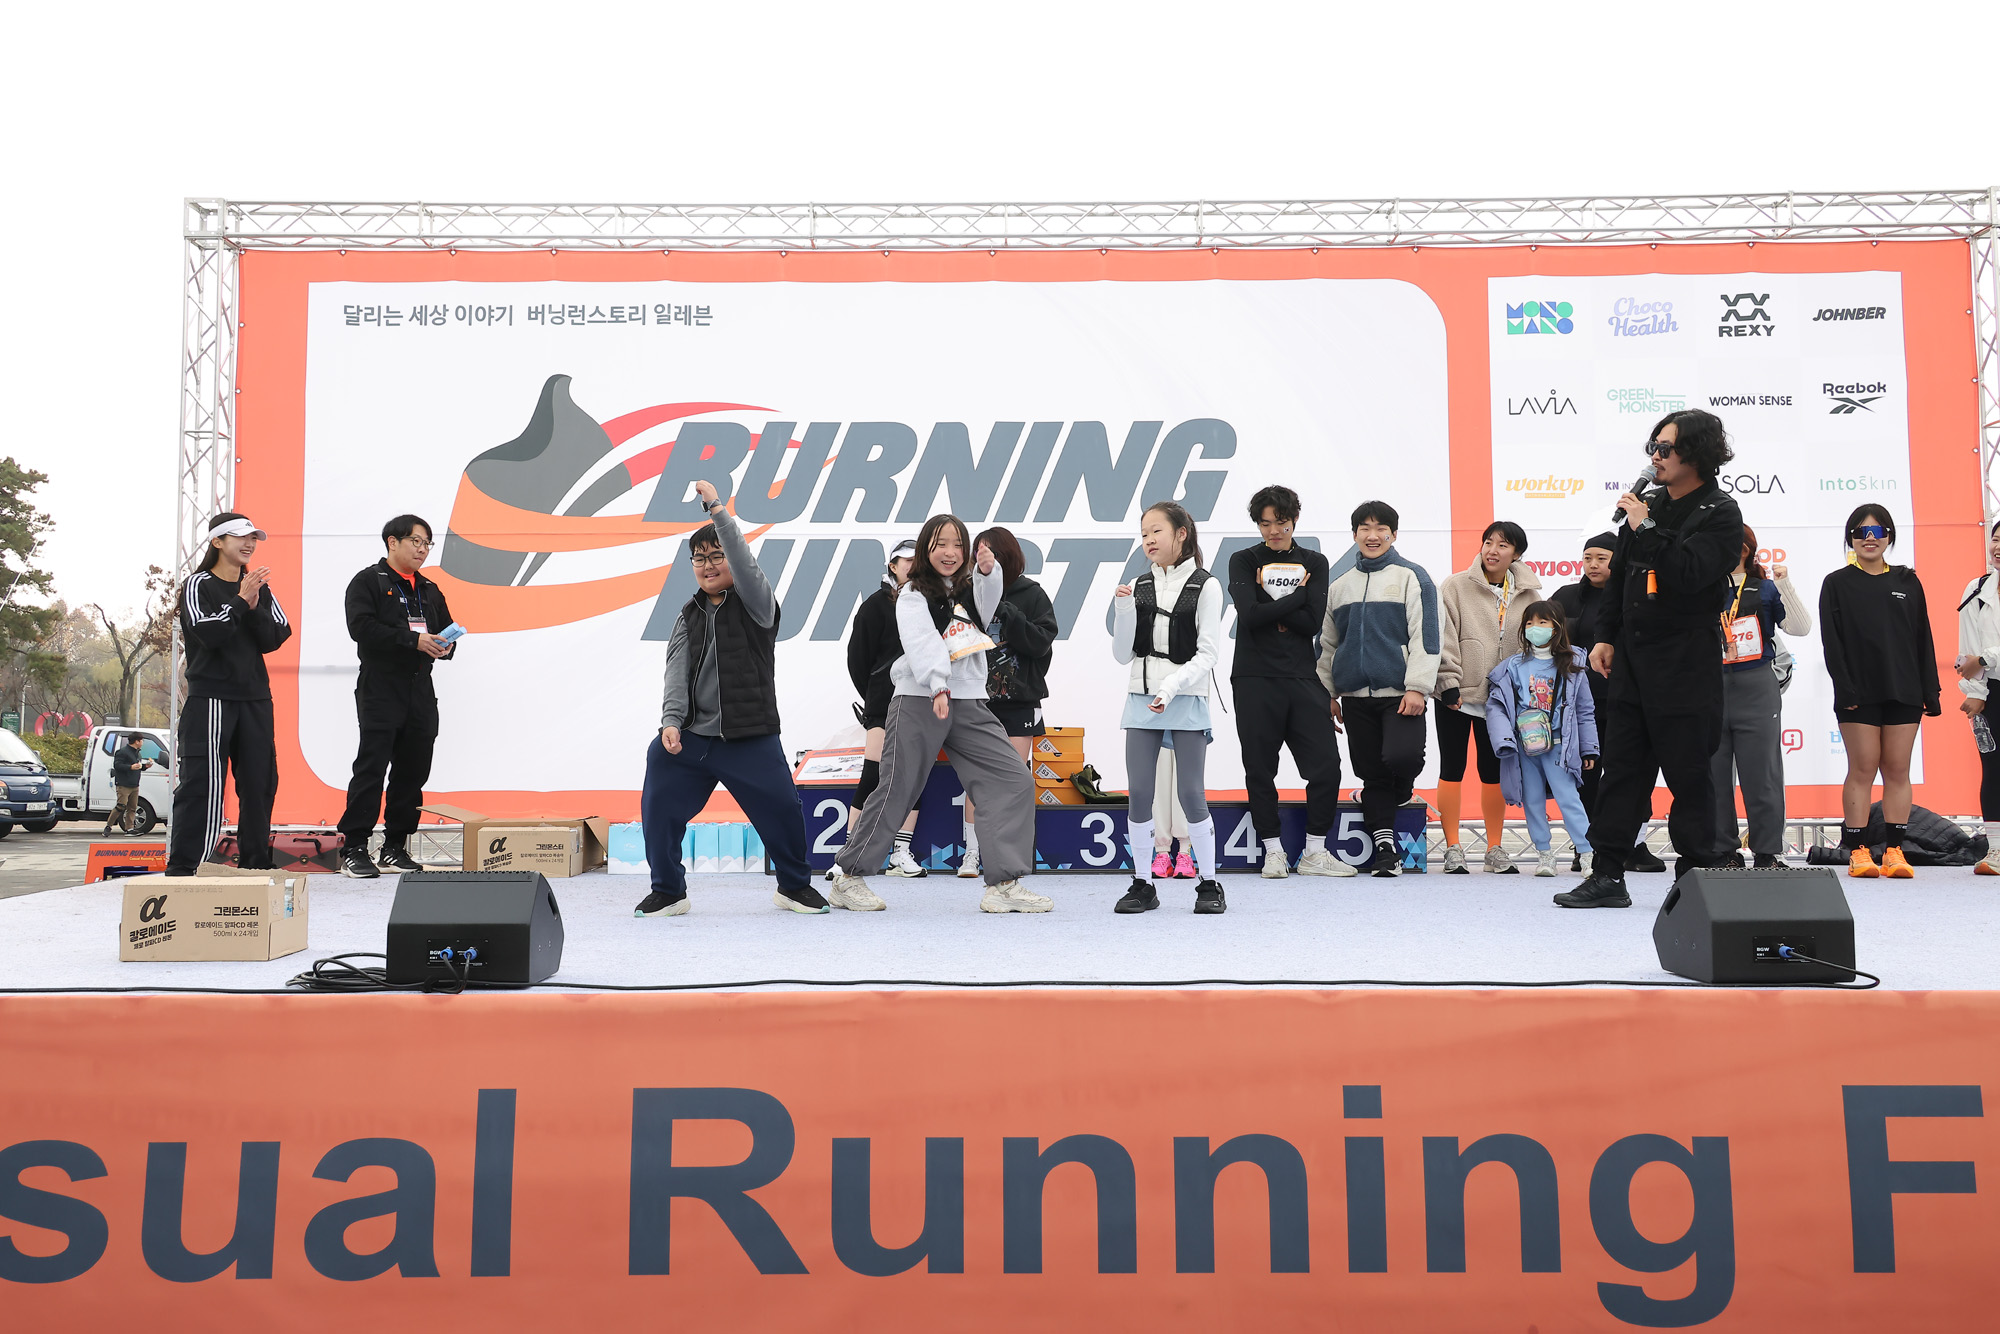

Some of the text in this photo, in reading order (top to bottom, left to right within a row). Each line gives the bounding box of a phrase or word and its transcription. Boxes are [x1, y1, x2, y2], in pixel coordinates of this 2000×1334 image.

[343, 303, 714, 327] 달리는 세상 이야기 버닝런스토리 일레븐
[1507, 301, 1574, 319] MONO
[1613, 297, 1673, 317] Choco
[1812, 306, 1887, 322] JOHNBER
[1507, 318, 1574, 335] MANO
[1608, 312, 1680, 337] Health
[1718, 324, 1776, 338] REXY
[1607, 388, 1655, 401] GREEN
[1822, 381, 1887, 397] Reebok
[1619, 400, 1686, 413] MONSTER
[1709, 395, 1793, 407] WOMAN SENSE
[642, 418, 1238, 523] BURNING
[1605, 481, 1620, 491] KN
[812, 798, 849, 854] 2
[1078, 811, 1116, 867] 3
[1223, 810, 1262, 864] 4
[1336, 812, 1374, 866] 5
[213, 906, 259, 917] 그린몬스터
[129, 919, 177, 943] 칼로에이드
[194, 921, 223, 929] 칼로에이드
[247, 921, 259, 929] 레몬
[628, 1087, 1736, 1330] Running
[1841, 1084, 1984, 1274] F
